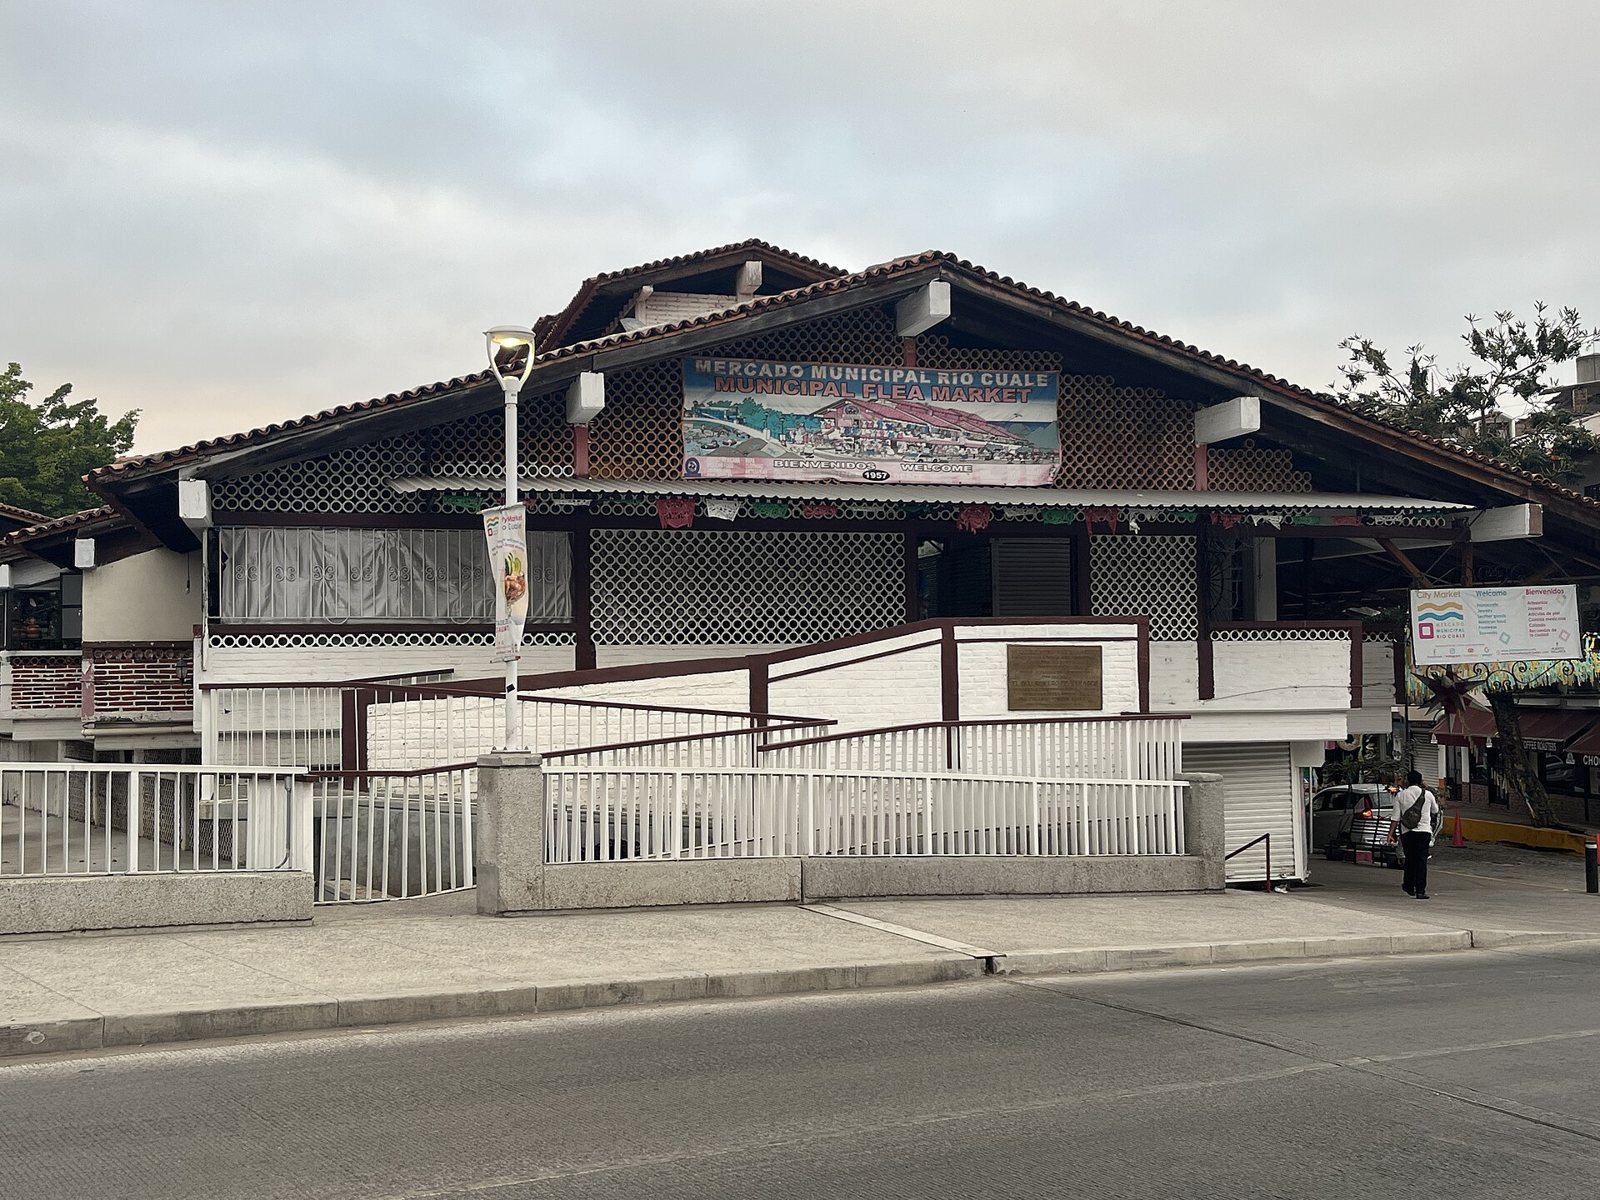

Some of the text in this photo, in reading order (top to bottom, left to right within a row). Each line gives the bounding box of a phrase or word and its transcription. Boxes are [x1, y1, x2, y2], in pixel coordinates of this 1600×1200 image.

[695, 359, 804, 378] MERCADO
[811, 365, 931, 384] MUNICIPAL
[980, 373, 1048, 387] CUALE
[714, 376, 1032, 403] MUNICIPAL FLEA MARKET
[773, 459, 877, 470] BIENVENIDOS
[900, 463, 973, 473] WELCOME
[864, 470, 888, 480] 1957
[1416, 590, 1461, 599] City Market
[1525, 587, 1565, 596] Bienvenidos
[1583, 755, 1600, 766] CHO
